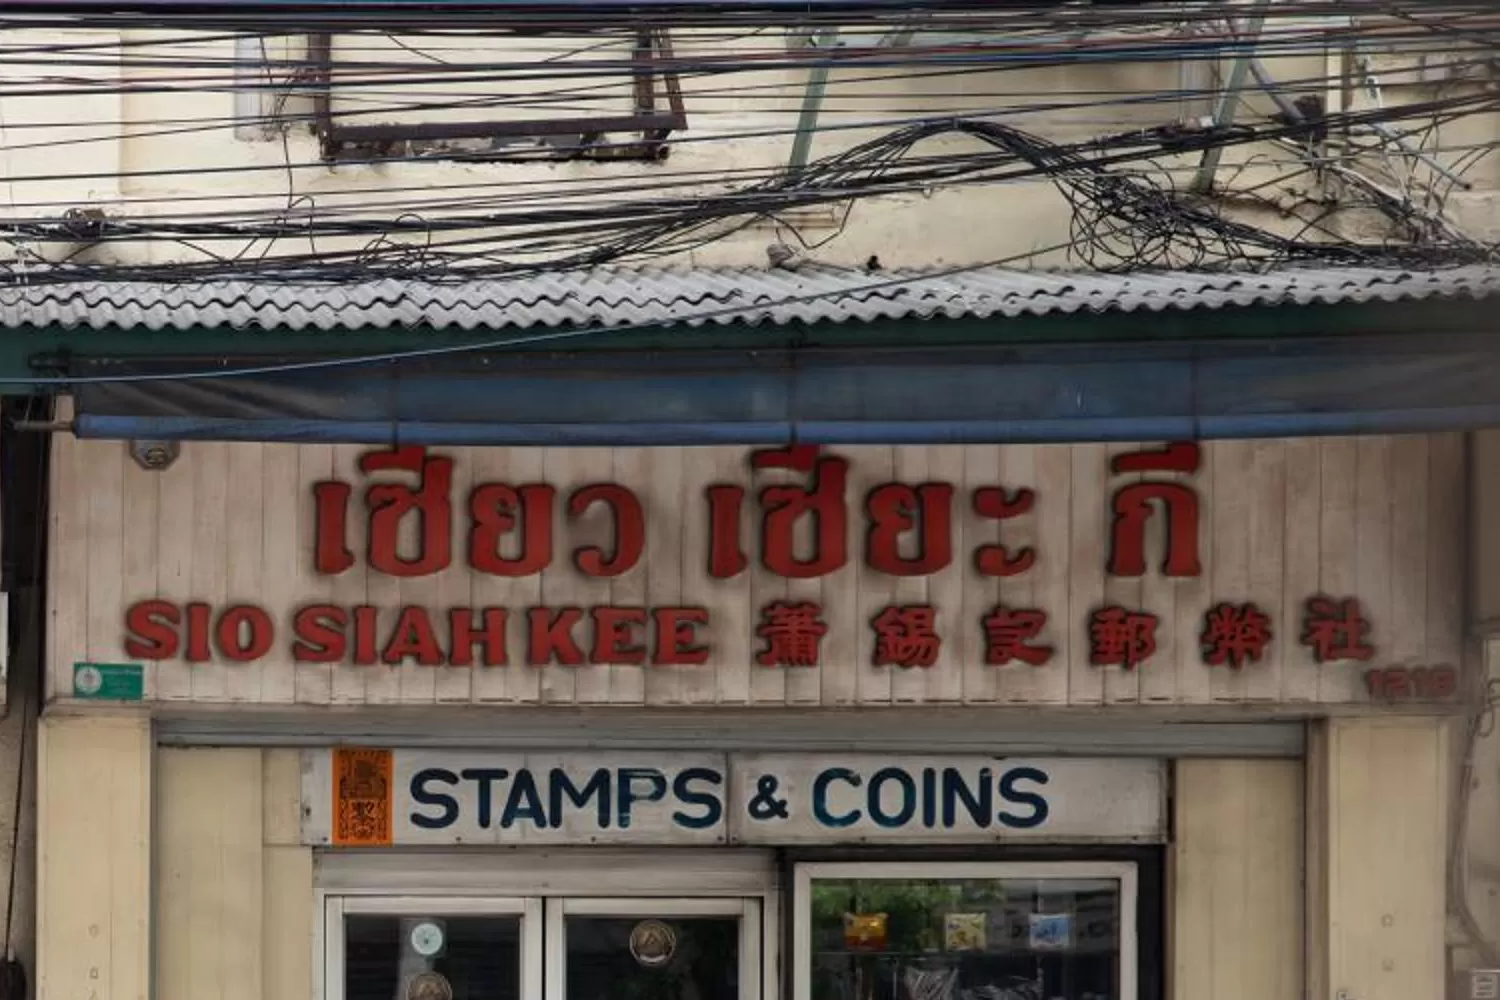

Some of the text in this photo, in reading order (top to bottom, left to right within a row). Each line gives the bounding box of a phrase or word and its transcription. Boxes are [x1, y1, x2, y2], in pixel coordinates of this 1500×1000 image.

[125, 599, 711, 666] SIO SIAH KEE
[408, 767, 722, 829] STAMPS
[747, 774, 789, 820] &
[811, 767, 1049, 829] COINS
